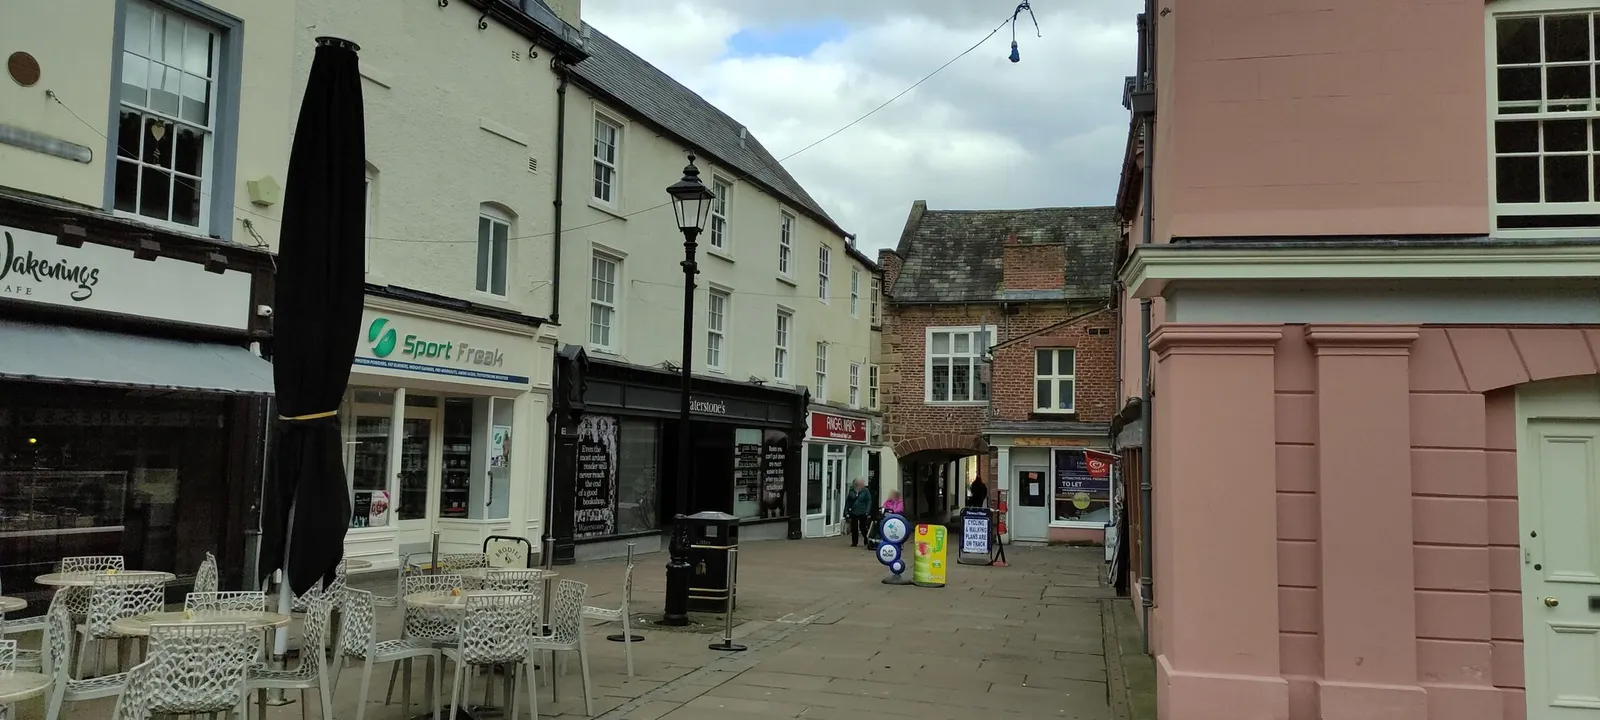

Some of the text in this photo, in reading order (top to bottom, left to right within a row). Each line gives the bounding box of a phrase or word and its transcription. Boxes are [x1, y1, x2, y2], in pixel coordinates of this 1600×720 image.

[4, 285, 32, 295] AFE
[403, 335, 504, 367] Sport Freak
[689, 395, 726, 414] aterstone's
[582, 444, 593, 453] Even
[583, 462, 598, 470] reader
[592, 479, 601, 487] end
[586, 488, 598, 498] good
